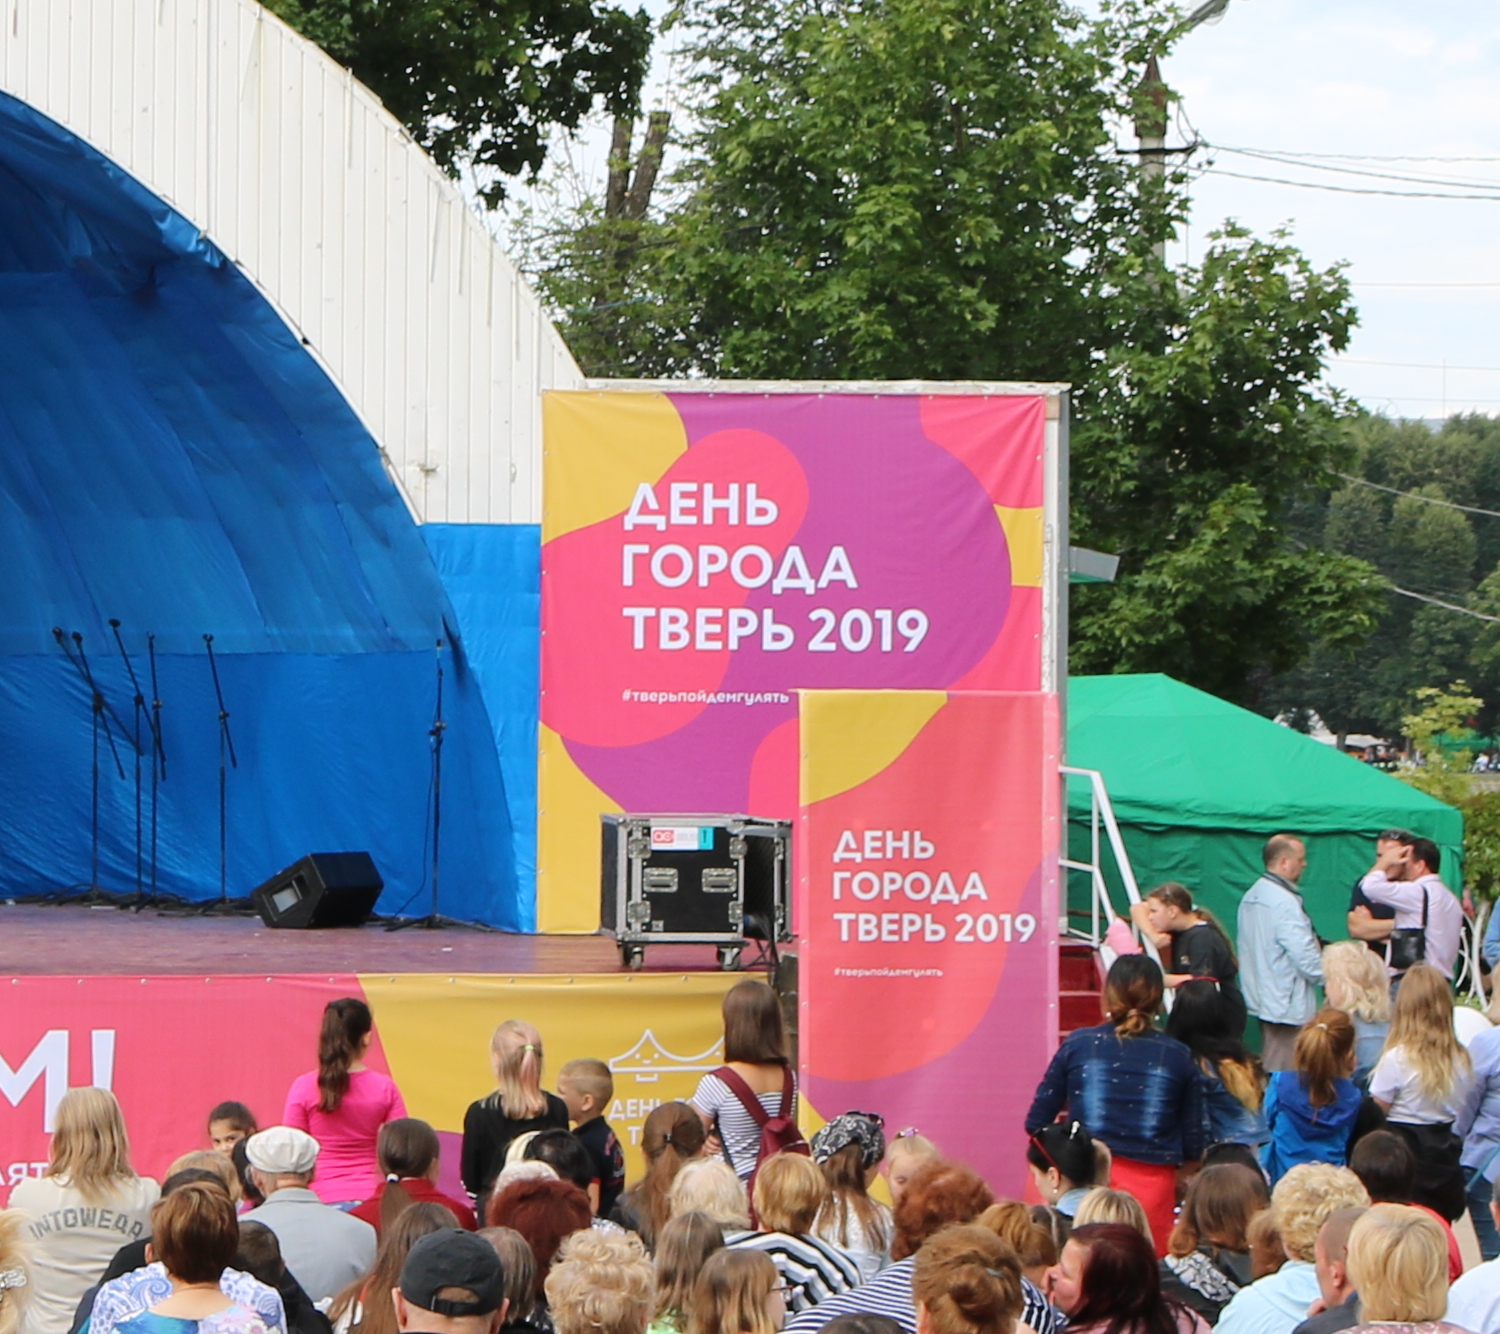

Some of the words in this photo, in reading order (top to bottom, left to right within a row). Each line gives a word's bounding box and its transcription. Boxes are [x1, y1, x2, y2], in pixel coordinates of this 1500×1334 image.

[622, 480, 779, 531] ДЕНЬ
[622, 544, 858, 595] ГОРОДА
[622, 607, 795, 651] ТВЕРЬ
[807, 608, 929, 652] 2019
[622, 689, 790, 706] #тверьпойдемгулять
[833, 830, 935, 863] ДЕНЬ
[833, 871, 989, 905] ГОРОДА
[833, 912, 946, 942] ТВЕРЬ
[954, 913, 1036, 942] 2019
